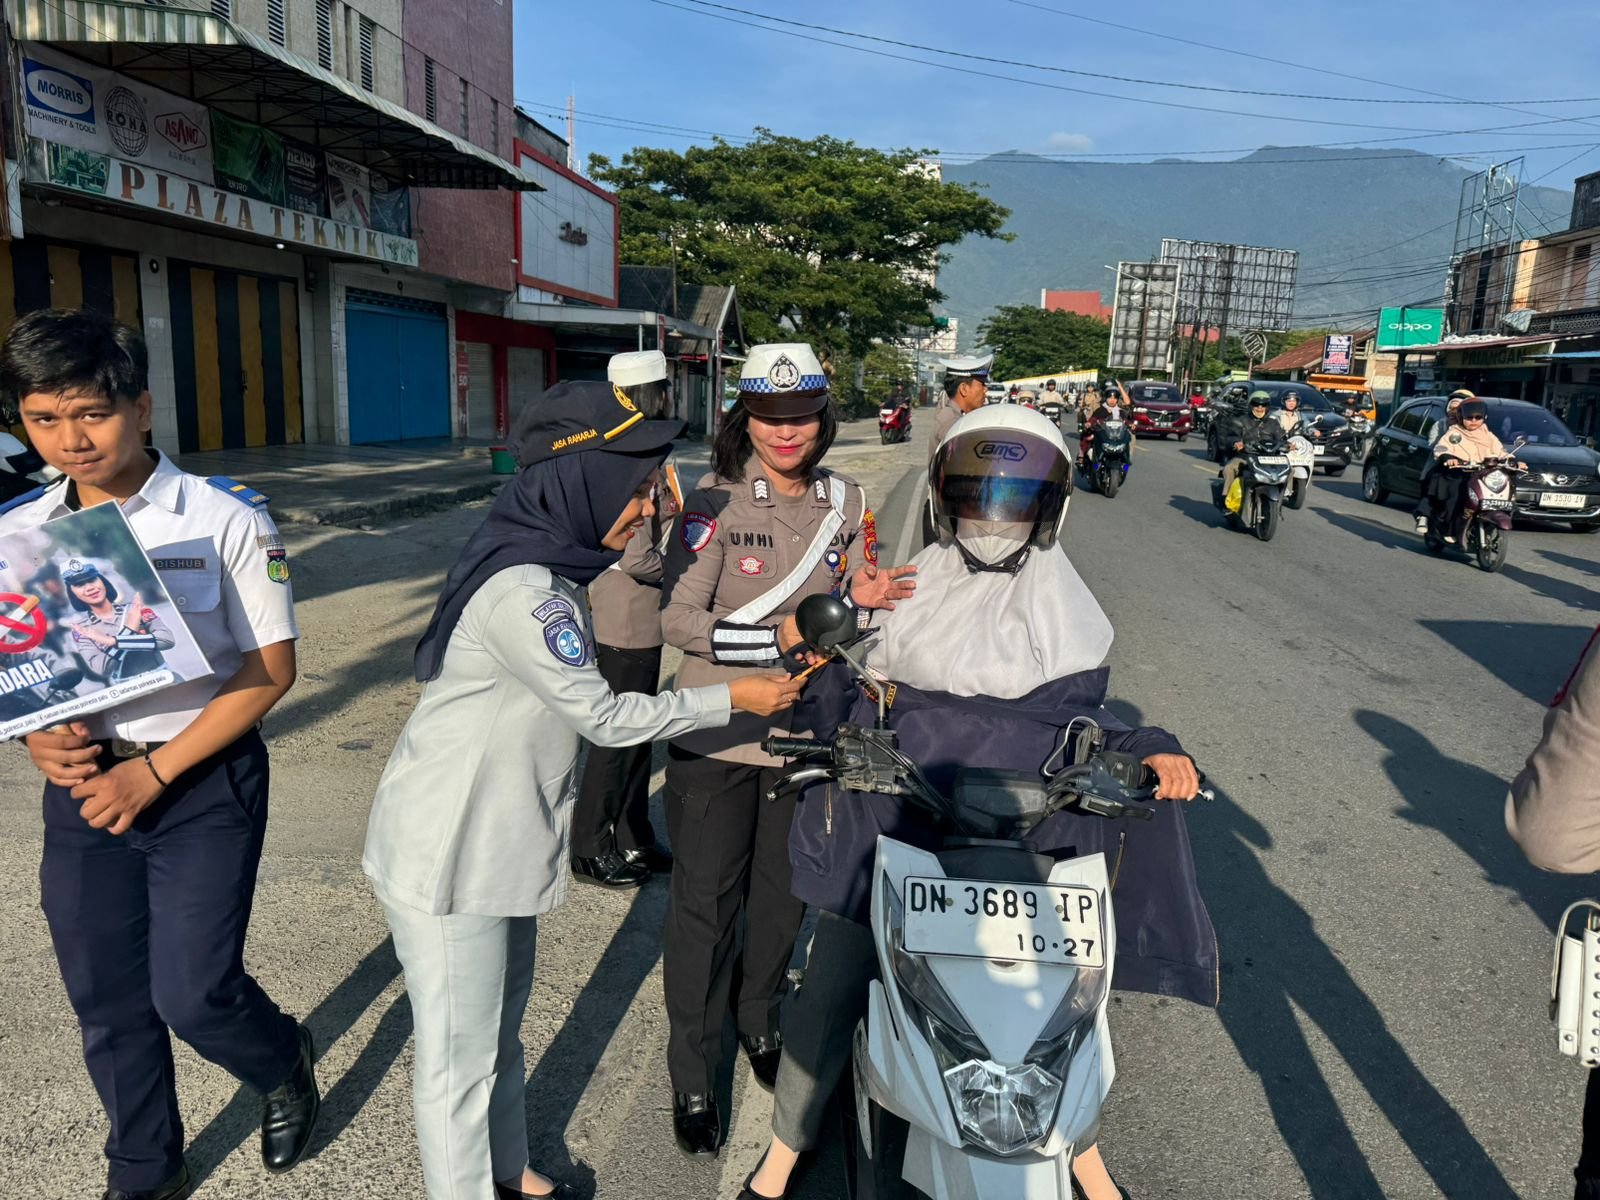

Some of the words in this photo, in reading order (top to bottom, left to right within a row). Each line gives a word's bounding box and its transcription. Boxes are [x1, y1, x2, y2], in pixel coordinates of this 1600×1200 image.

[37, 79, 83, 105] MORRIS
[27, 106, 67, 127] MACHINERY
[74, 121, 96, 134] TOOLS
[165, 117, 199, 145] ASANO
[118, 162, 254, 230] PLAZA
[270, 206, 381, 258] TEKNIK
[551, 438, 568, 451] JASA
[567, 428, 598, 445] RAHARJA
[730, 532, 773, 548] UNHI
[156, 560, 202, 570] DISHUB
[0, 657, 53, 694] DARA
[911, 882, 947, 913] DN
[963, 886, 1038, 919] 3689
[1060, 893, 1093, 924] IP
